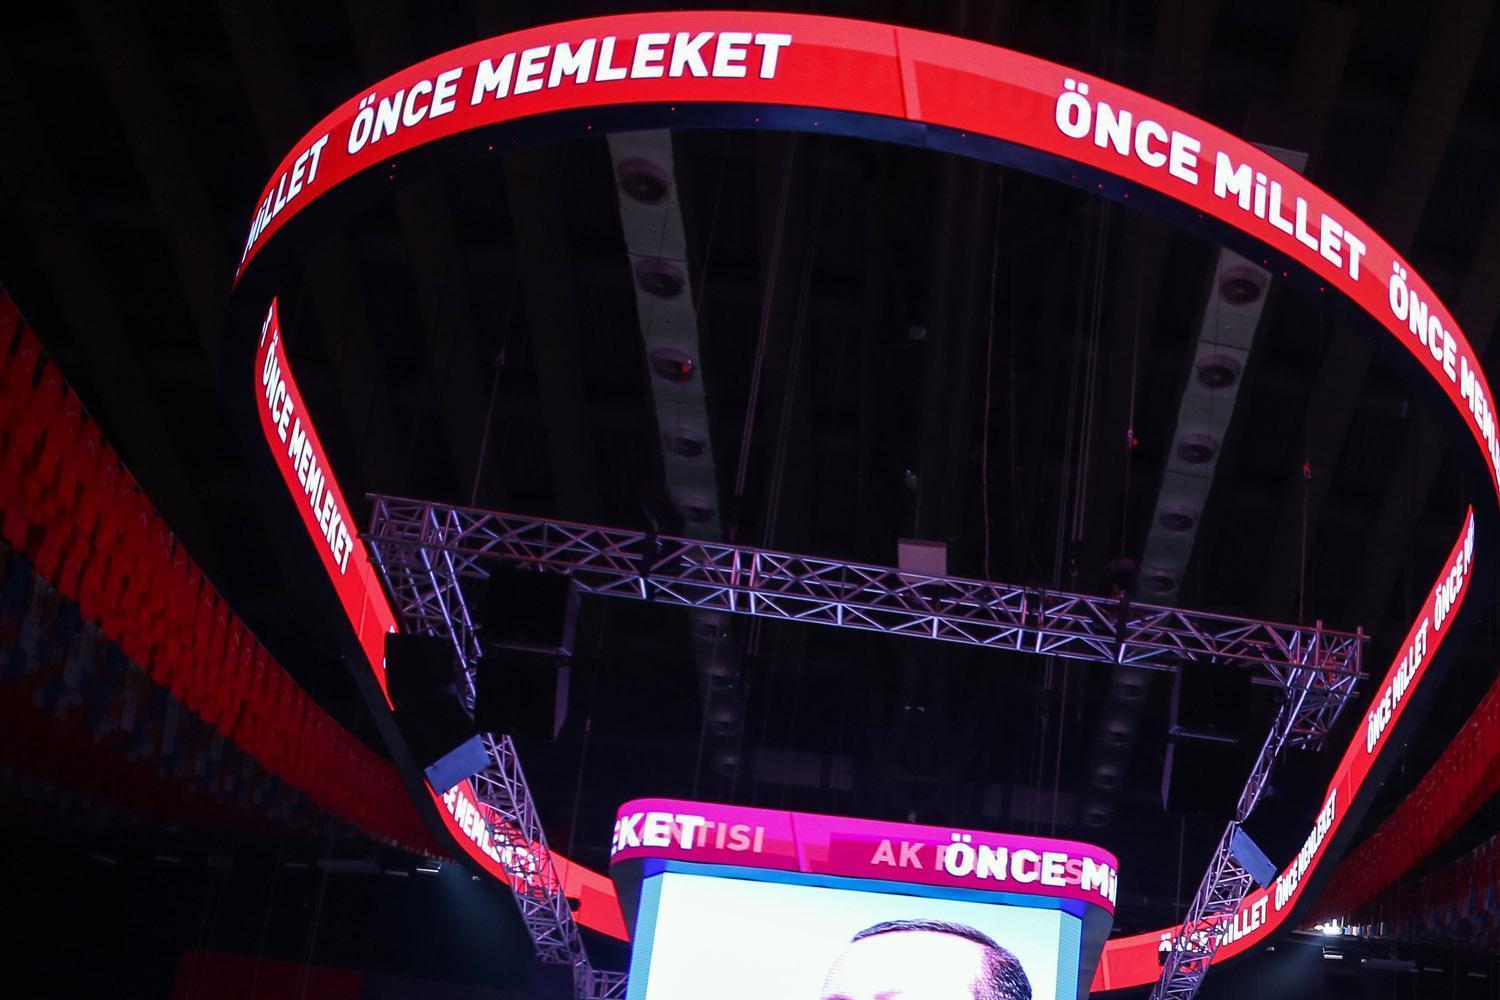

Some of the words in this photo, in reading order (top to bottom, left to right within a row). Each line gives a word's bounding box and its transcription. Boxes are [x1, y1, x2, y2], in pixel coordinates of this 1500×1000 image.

[347, 67, 462, 155] ÖNCE
[470, 31, 793, 105] MEMLEKET
[1055, 78, 1200, 185] ÖNCE
[1388, 261, 1457, 383] ÖNCE
[263, 328, 294, 444] ÖNCE
[288, 417, 354, 575] MEMLEKET
[1366, 697, 1393, 754] ÖNCE
[1433, 550, 1464, 631] ÖNCE
[944, 833, 1069, 887] ÖNCE
[1274, 853, 1298, 911] ÖNCE
[1297, 788, 1337, 881] MEMLEKET
